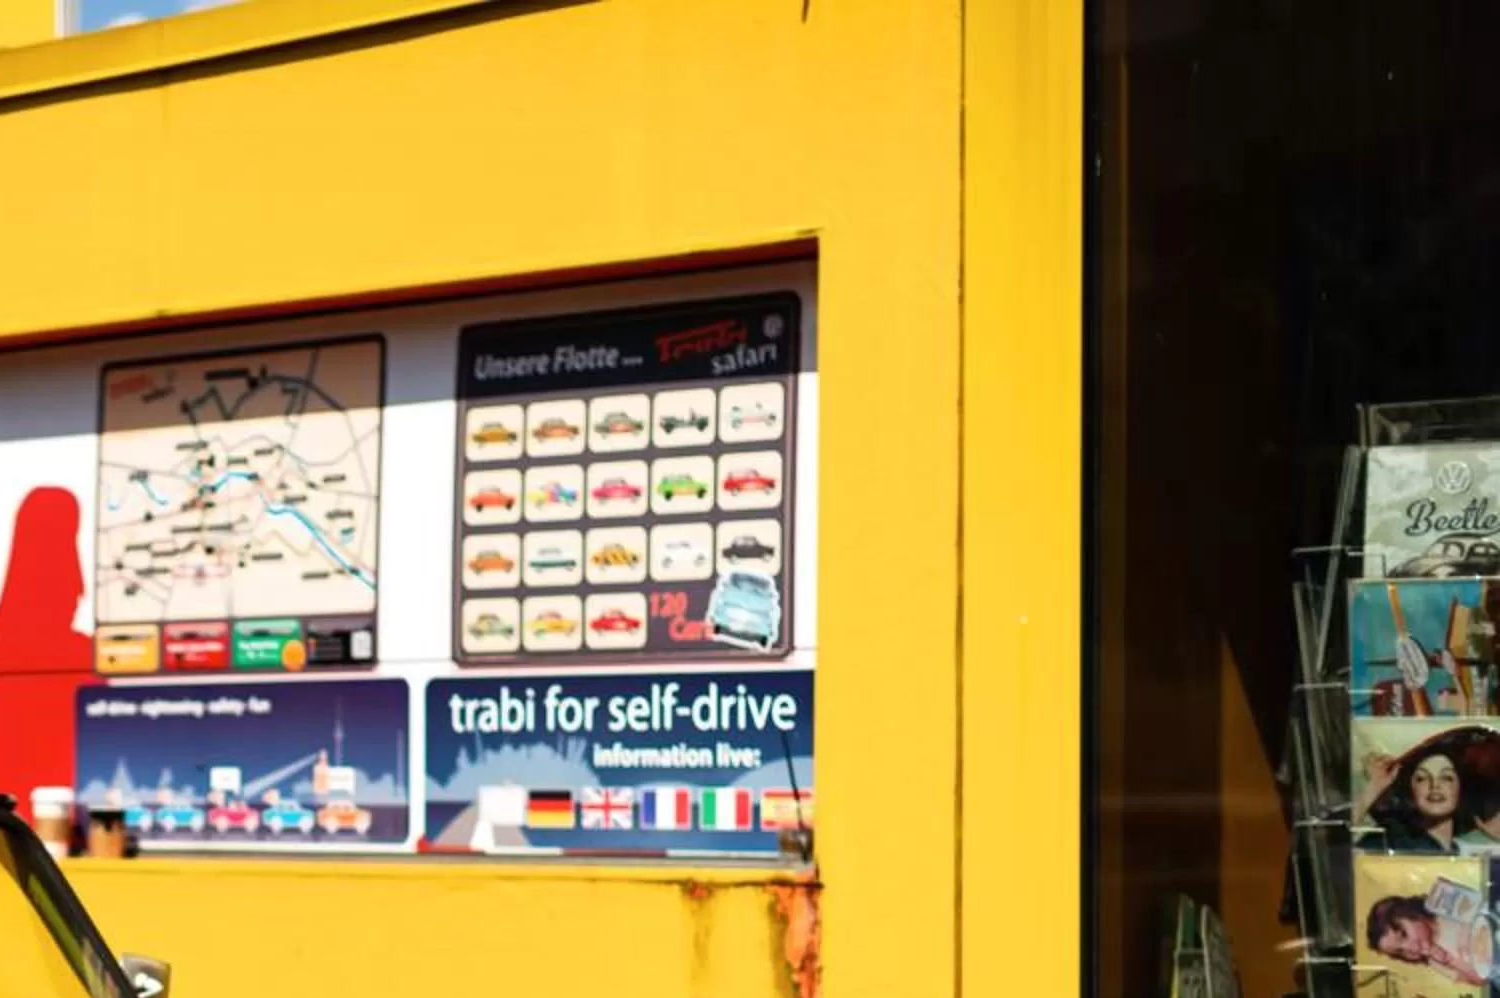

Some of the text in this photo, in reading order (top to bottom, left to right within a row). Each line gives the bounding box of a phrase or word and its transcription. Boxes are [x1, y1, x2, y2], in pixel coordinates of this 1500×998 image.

[474, 352, 549, 381] Unsere
[711, 342, 777, 375] safari
[1404, 497, 1500, 536] Beetle
[449, 682, 797, 733] trabi for self-drive
[593, 741, 761, 768] information live:
